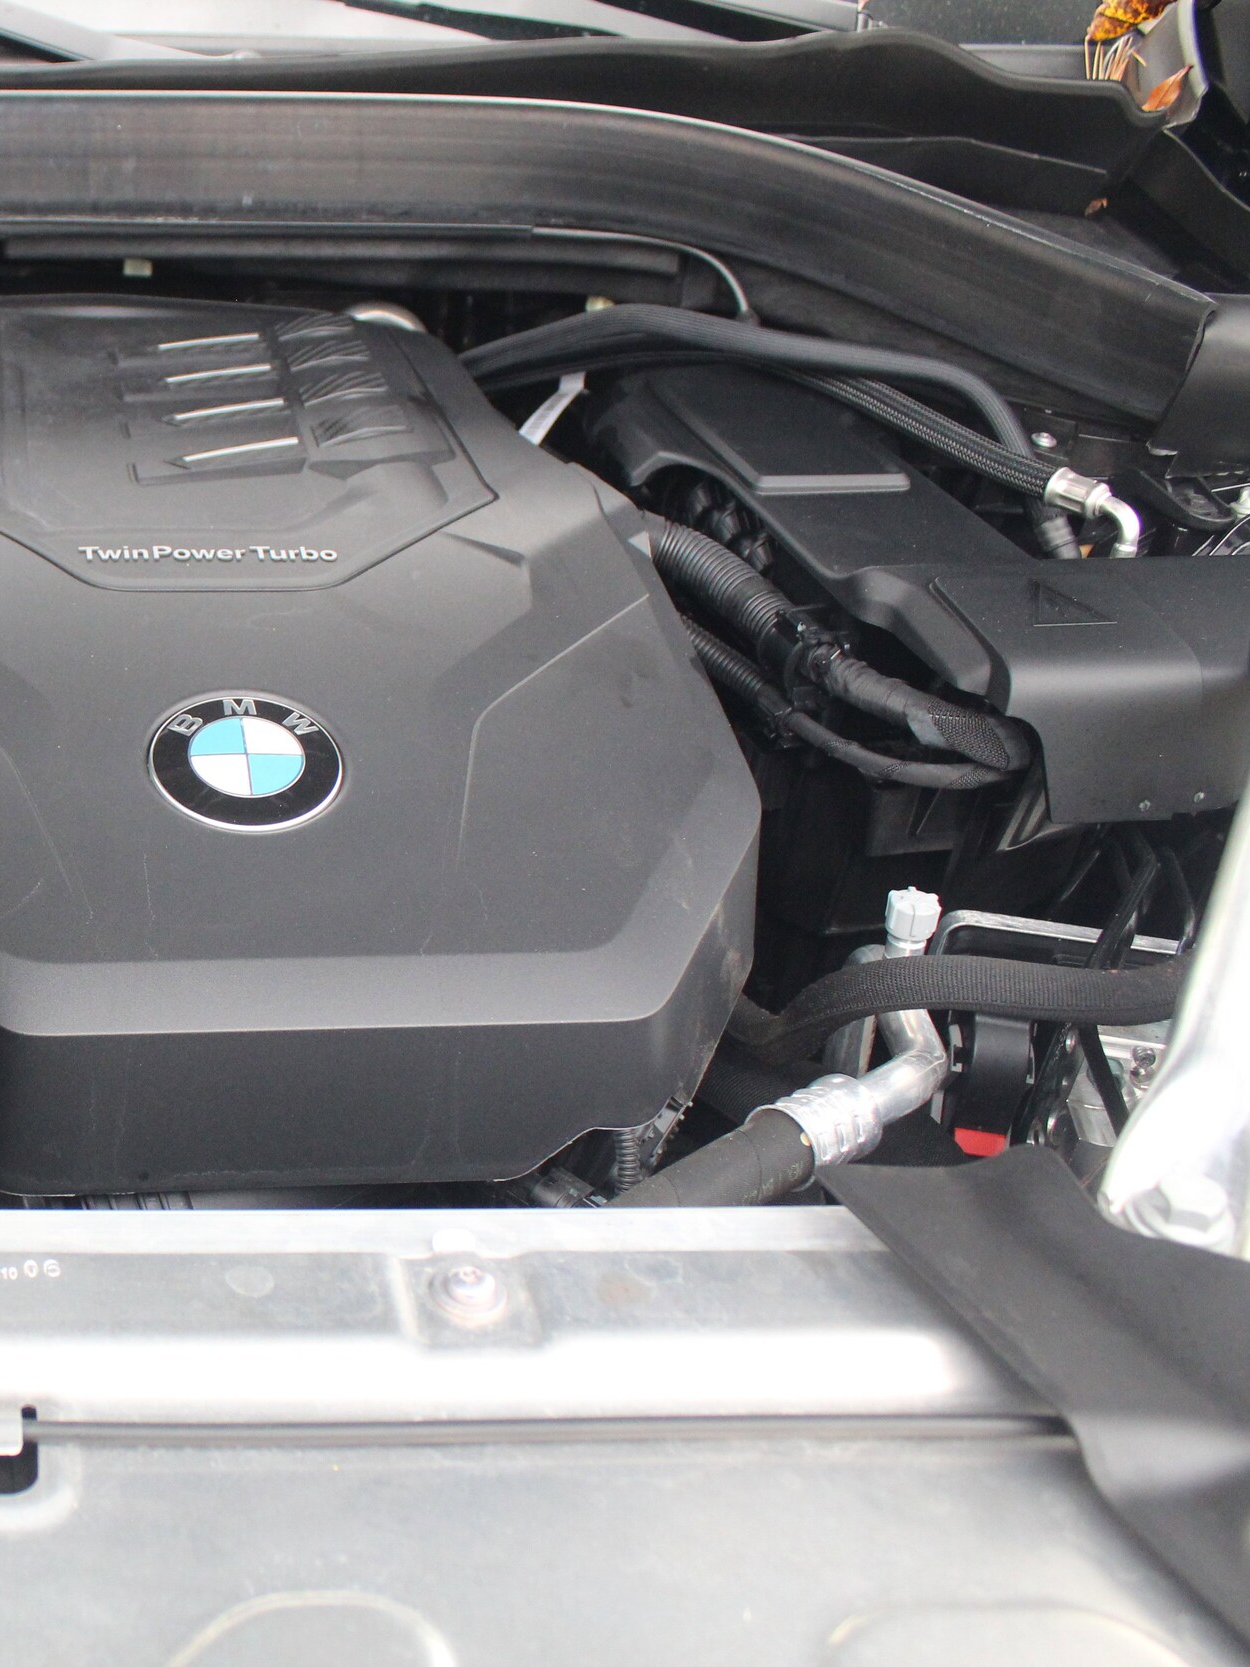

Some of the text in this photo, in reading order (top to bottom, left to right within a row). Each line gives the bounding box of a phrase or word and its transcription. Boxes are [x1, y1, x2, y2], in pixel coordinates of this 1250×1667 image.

[249, 546, 338, 562] Turbo
[167, 698, 320, 737] BMW
[23, 1259, 62, 1278] 06
